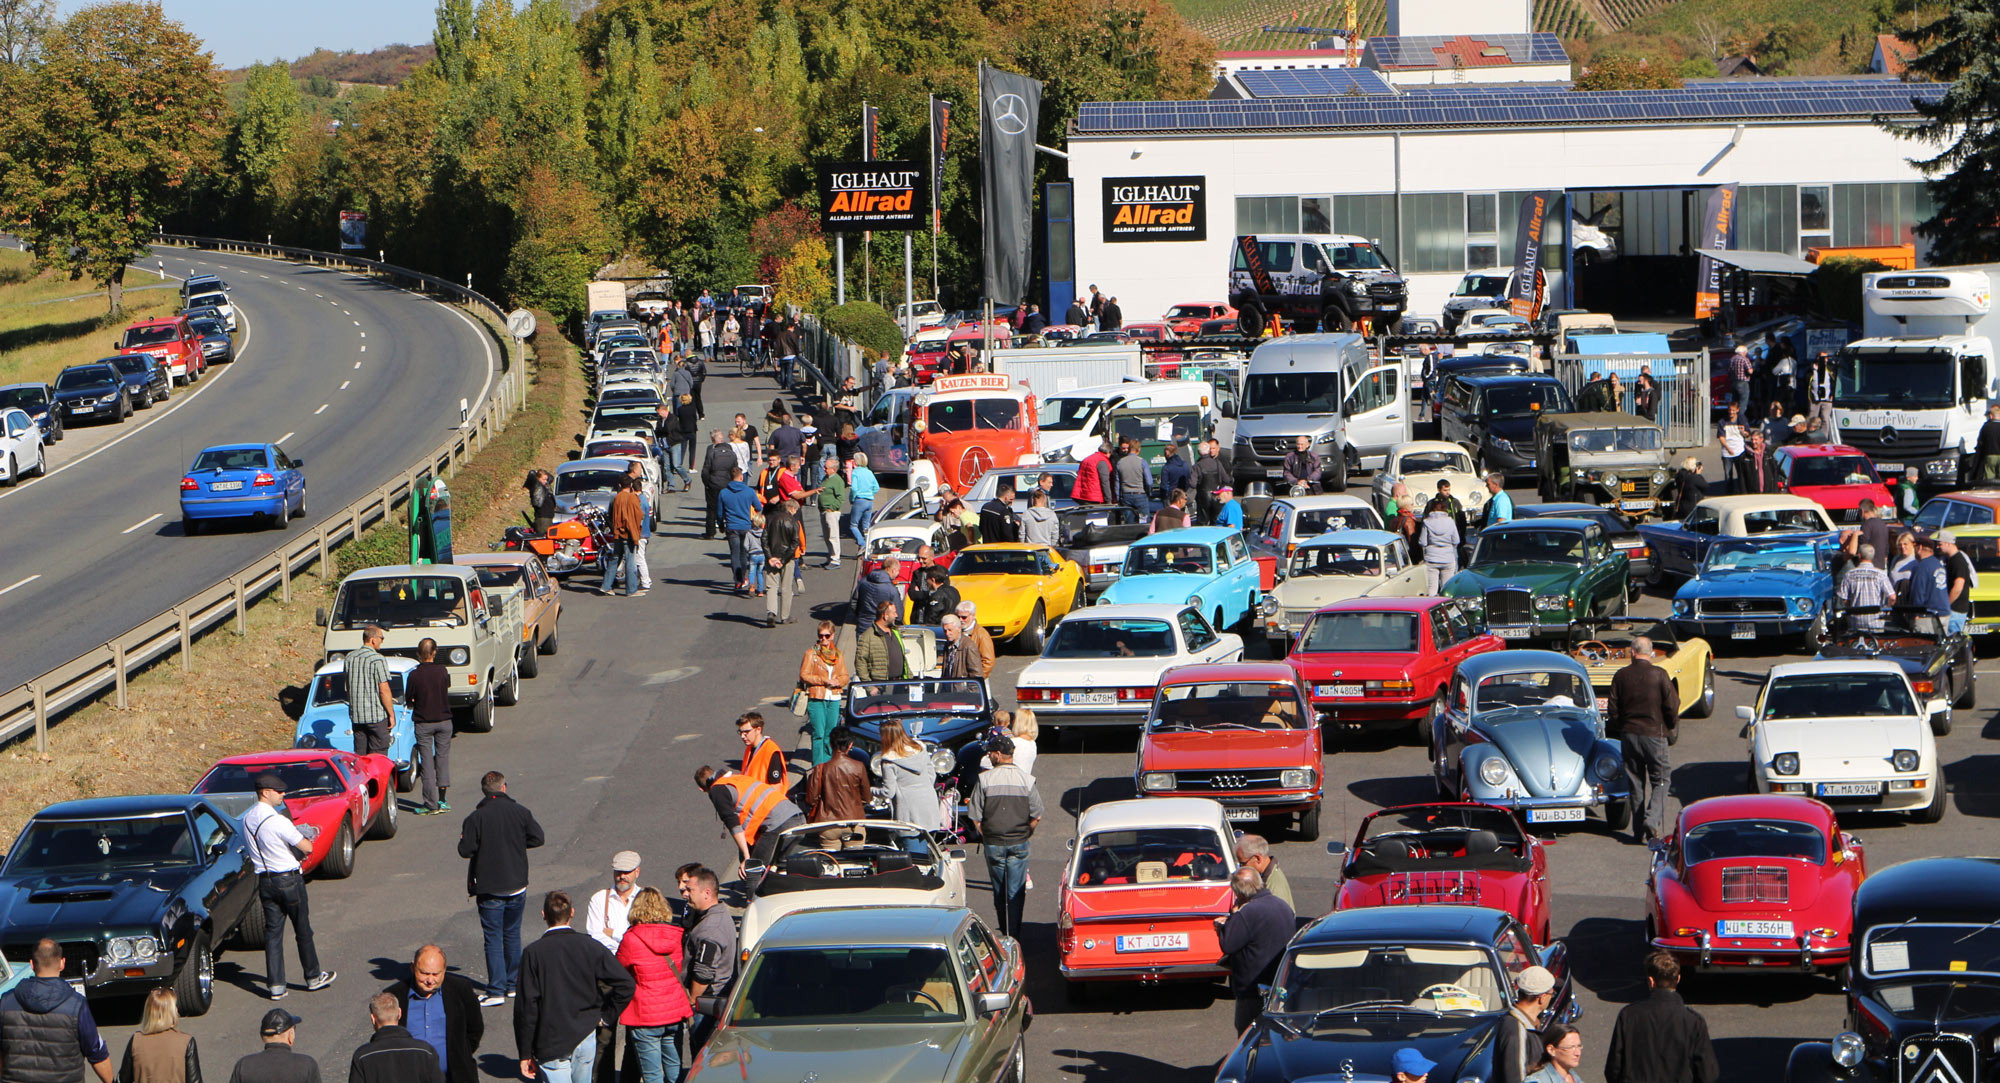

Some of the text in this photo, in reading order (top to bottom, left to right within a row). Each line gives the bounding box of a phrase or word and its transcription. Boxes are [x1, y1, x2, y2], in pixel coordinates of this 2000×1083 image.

[831, 171, 914, 189] IGLHAUT
[829, 190, 914, 213] Allrad
[1112, 185, 1194, 202] IGLHAUT
[1113, 203, 1194, 225] Allrad
[1529, 196, 1544, 241] Allrad
[1717, 189, 1732, 234] Allrad
[1521, 244, 1537, 296] IGLHAUT
[513, 316, 530, 331] 70
[941, 377, 1004, 389] KAUZEN BIER
[1859, 413, 1918, 428] CharterWay
[1824, 785, 1834, 794] KT
[1855, 784, 1877, 793] 924H
[1554, 810, 1566, 820] BJ
[1570, 810, 1581, 819] 58
[1726, 922, 1784, 933] WÜ E 356H
[1128, 935, 1182, 948] KT 0734
